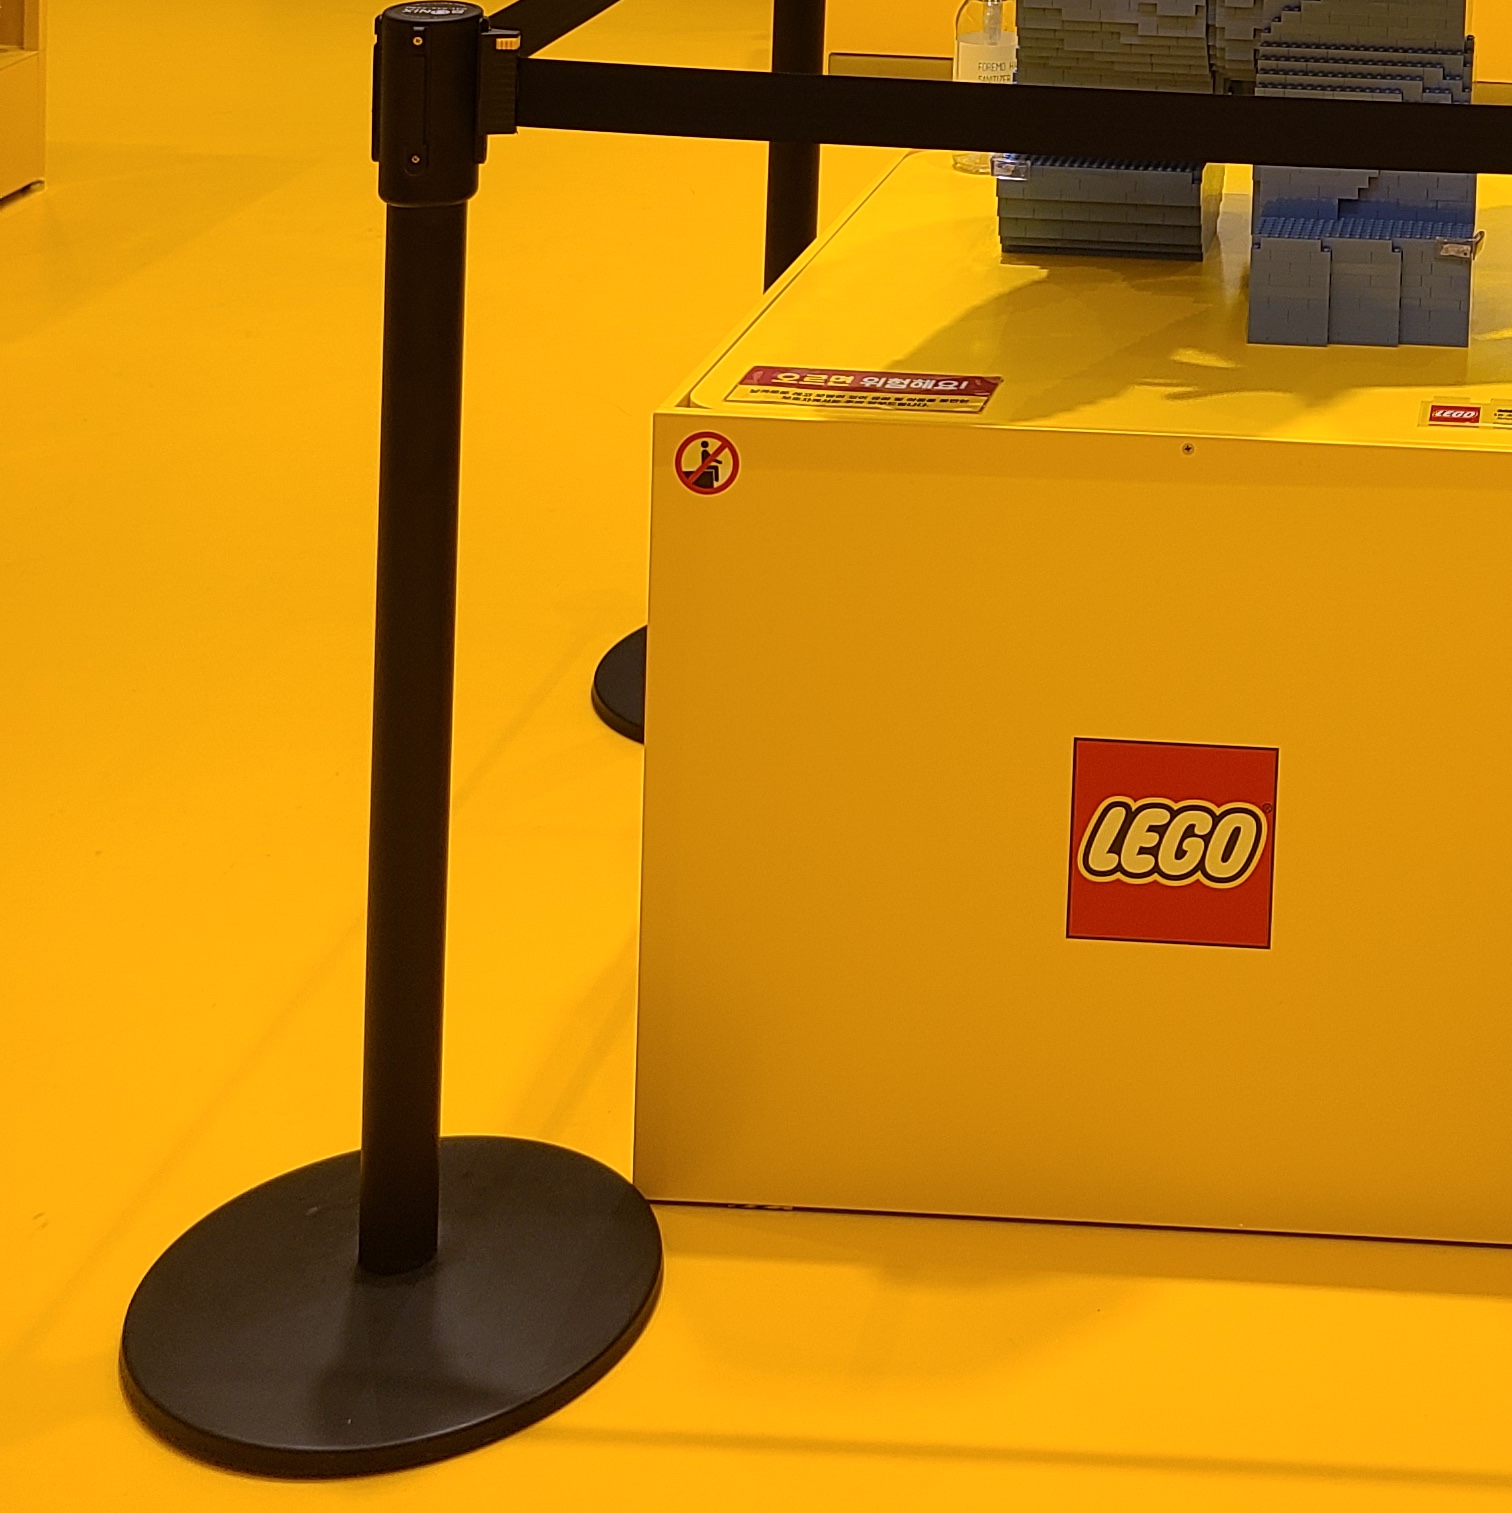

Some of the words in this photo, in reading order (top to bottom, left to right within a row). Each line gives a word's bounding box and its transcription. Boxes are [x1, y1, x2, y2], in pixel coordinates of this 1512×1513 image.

[771, 372, 854, 387] 오르면
[860, 376, 969, 391] 위험해요!
[1077, 795, 1269, 889] LEGO
